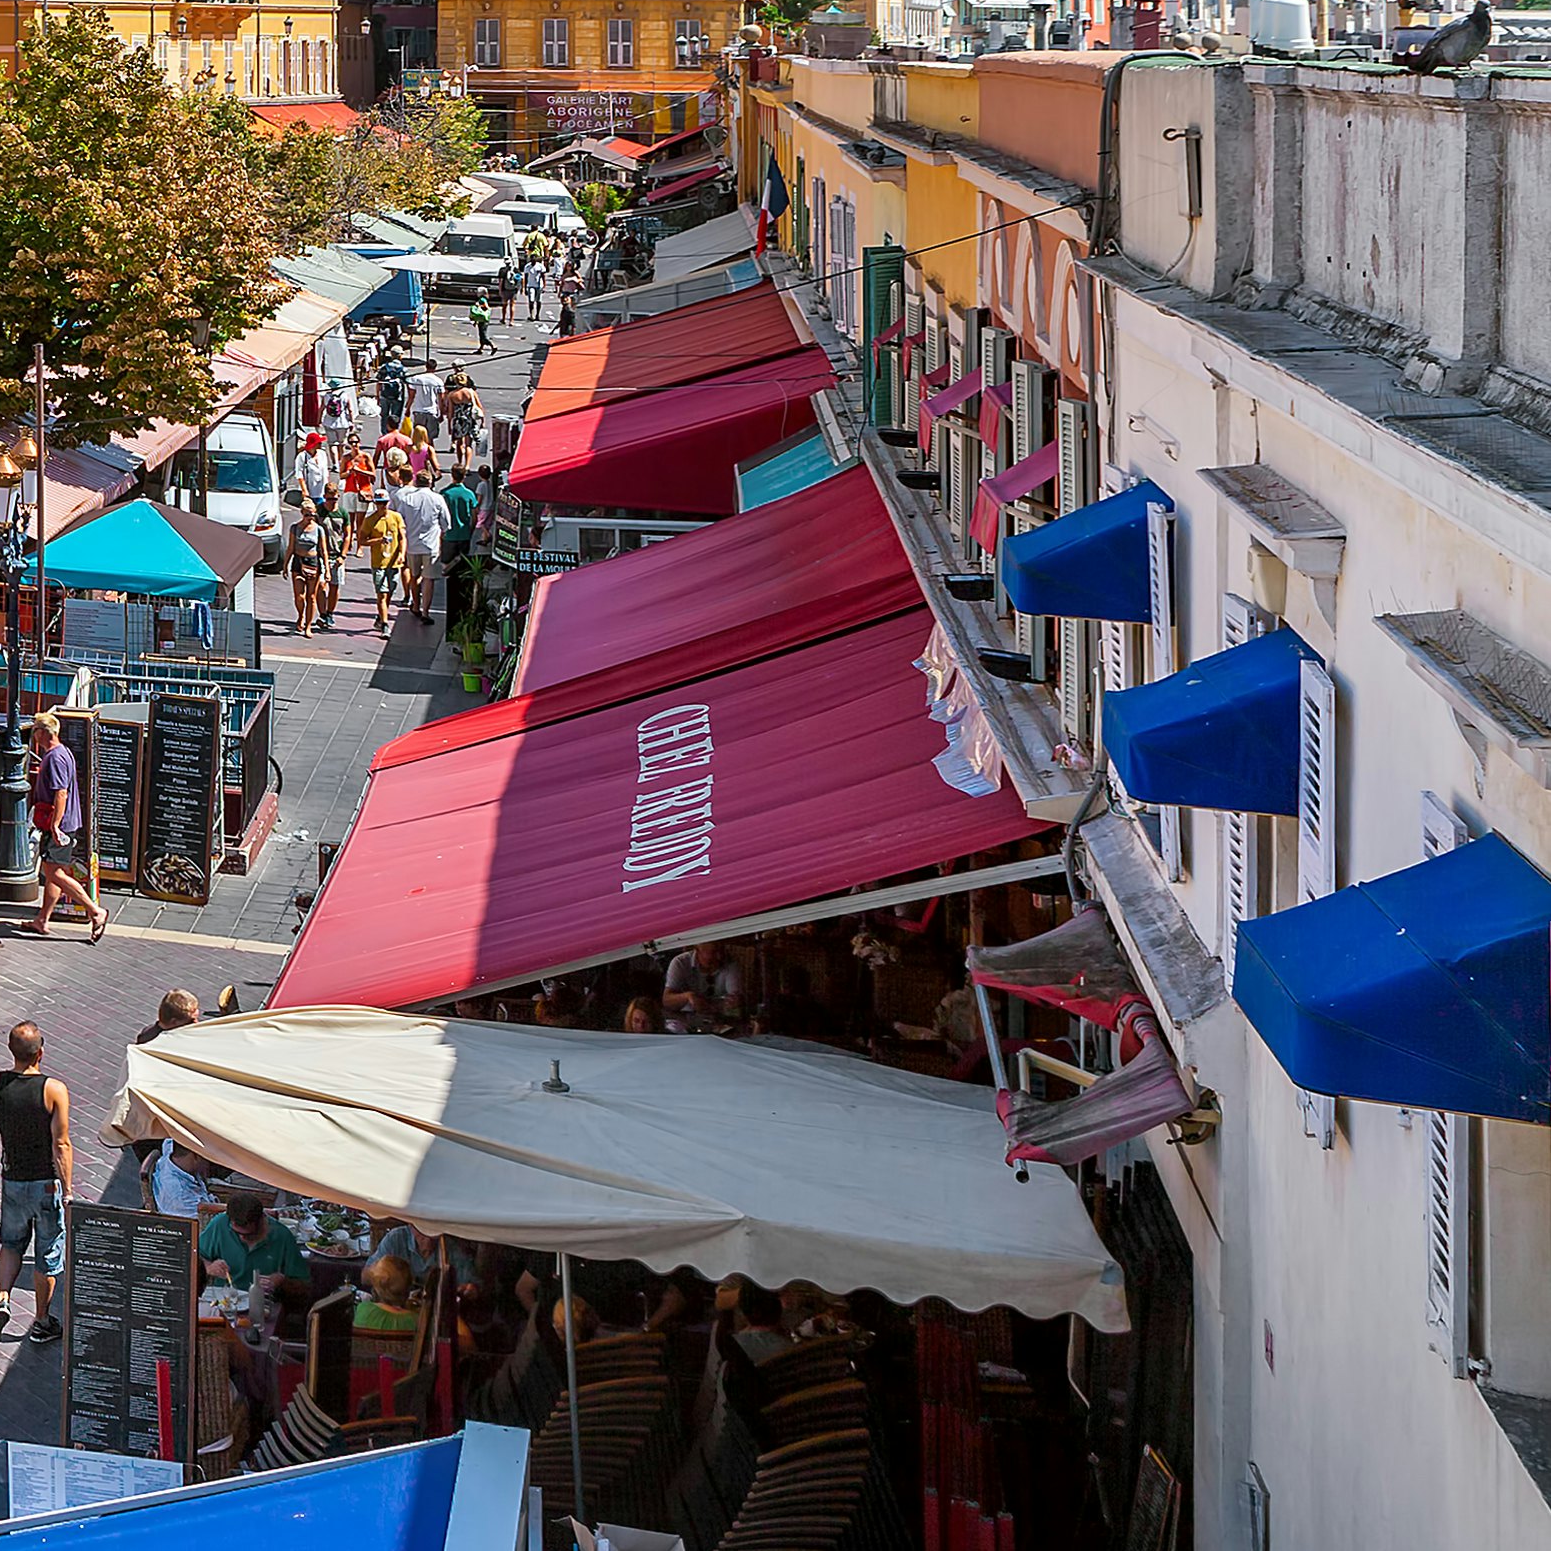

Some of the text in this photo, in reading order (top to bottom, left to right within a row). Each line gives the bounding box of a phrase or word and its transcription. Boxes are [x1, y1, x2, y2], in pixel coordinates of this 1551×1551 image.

[546, 95, 595, 105] GALERIE
[547, 119, 562, 128] ET
[519, 551, 531, 560] LE
[533, 552, 576, 563] FESTIVAL
[519, 563, 531, 572] DE
[533, 563, 544, 573] LA
[622, 704, 716, 893] CHEZ FREDDY
